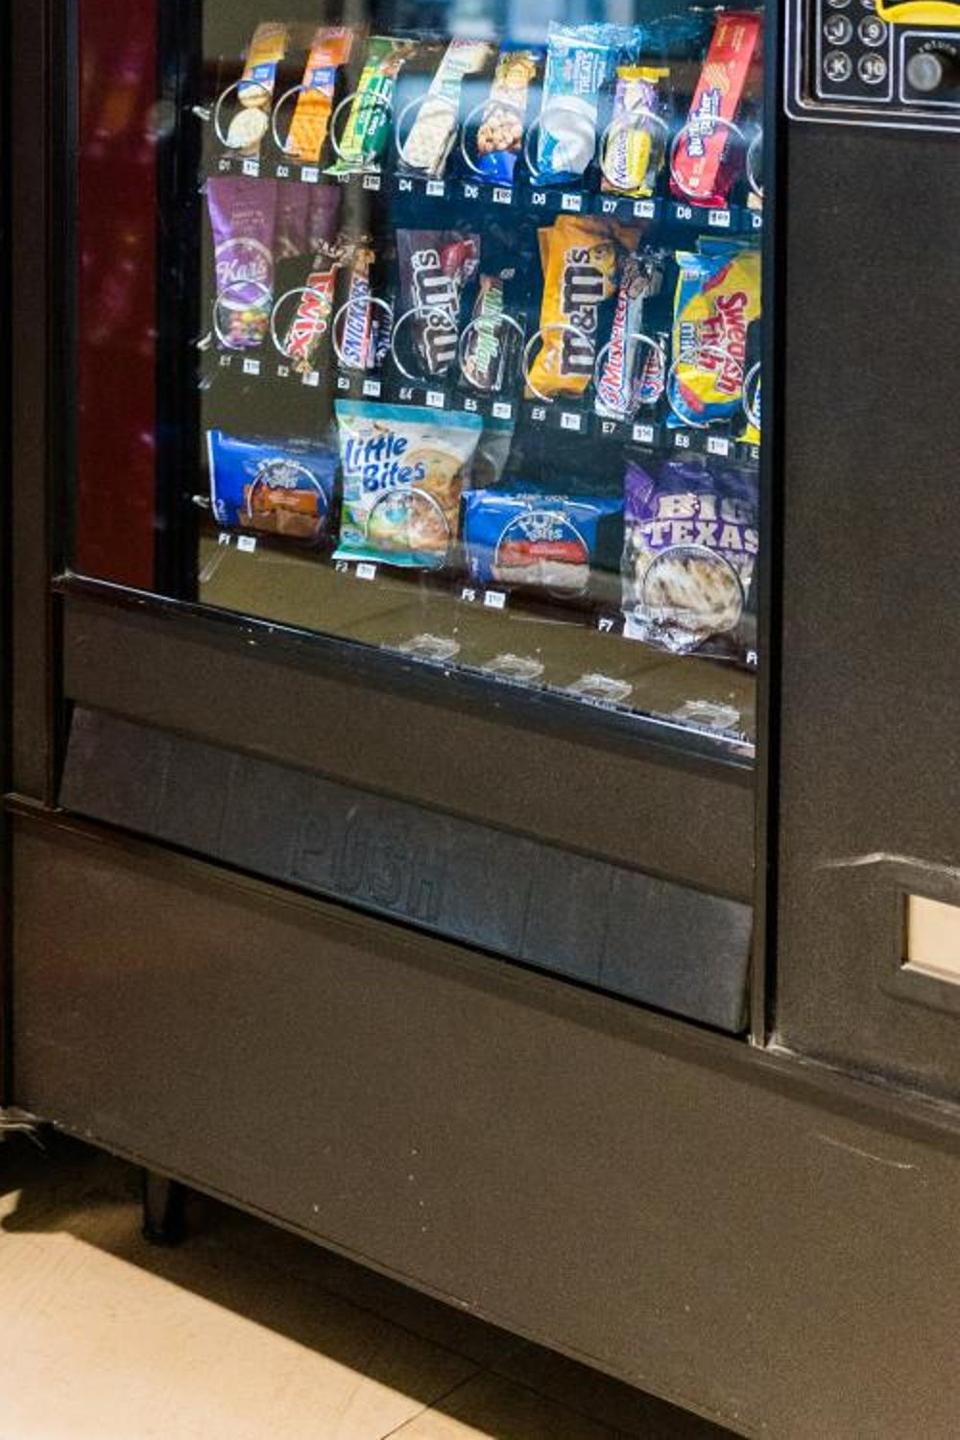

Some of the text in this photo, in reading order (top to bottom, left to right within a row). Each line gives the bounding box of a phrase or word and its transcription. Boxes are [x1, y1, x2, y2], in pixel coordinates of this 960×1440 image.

[834, 22, 844, 37] J
[867, 24, 878, 38] 9
[834, 60, 846, 74] K
[602, 201, 617, 213] D7
[343, 277, 369, 363] SNICKERS
[603, 422, 617, 433] E7
[675, 435, 689, 447] E8
[345, 432, 409, 474] Little
[361, 461, 426, 492] Bites
[640, 520, 759, 554] TEXAS
[598, 619, 613, 632] F7
